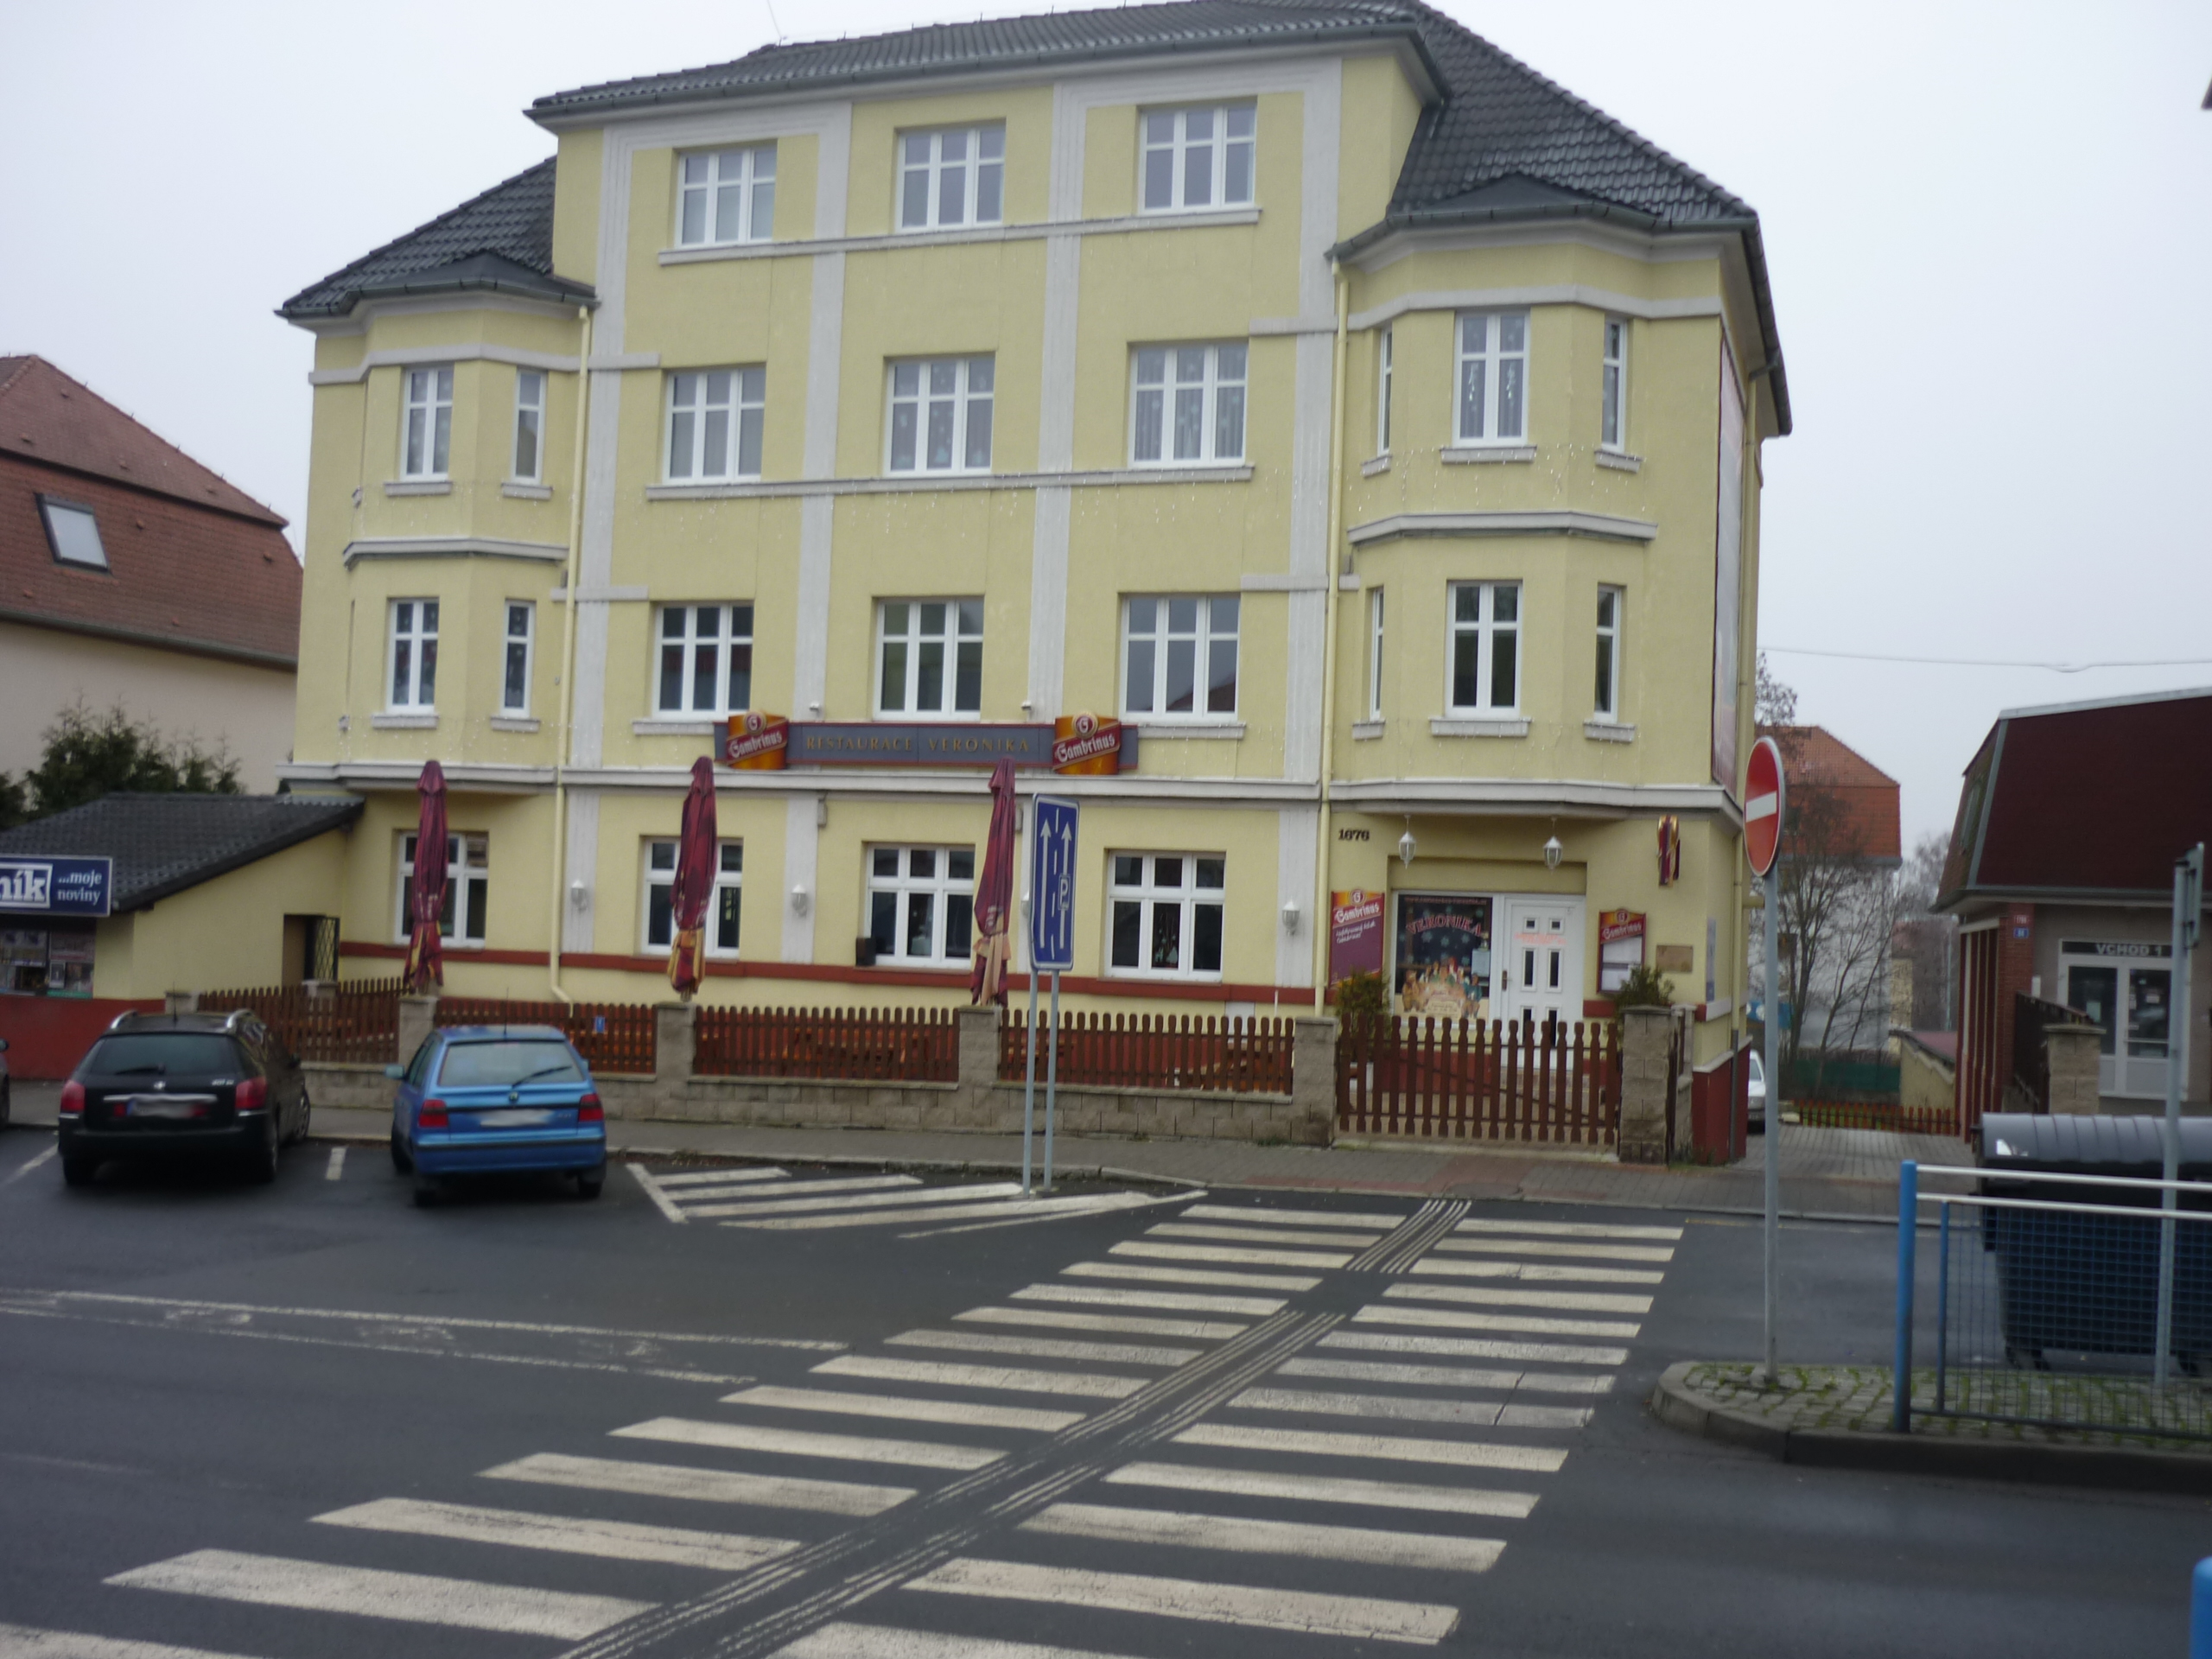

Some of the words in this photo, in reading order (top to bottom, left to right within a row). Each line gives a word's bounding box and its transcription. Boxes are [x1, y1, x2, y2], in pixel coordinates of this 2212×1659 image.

[728, 730, 783, 759] Gambrinus
[806, 736, 913, 752] RESTAURACE
[928, 737, 1031, 753] VERONIKA
[1054, 733, 1116, 763] Gambrinus
[1338, 829, 1370, 842] 1676
[57, 887, 101, 906] noviny
[1060, 879, 1069, 903] P
[1334, 902, 1380, 924] Gambrinus
[1406, 913, 1482, 937] VERONIKA
[1602, 922, 1642, 939] Gambrinus
[2095, 943, 2150, 957] VCHOD
[2154, 945, 2163, 957] 1
